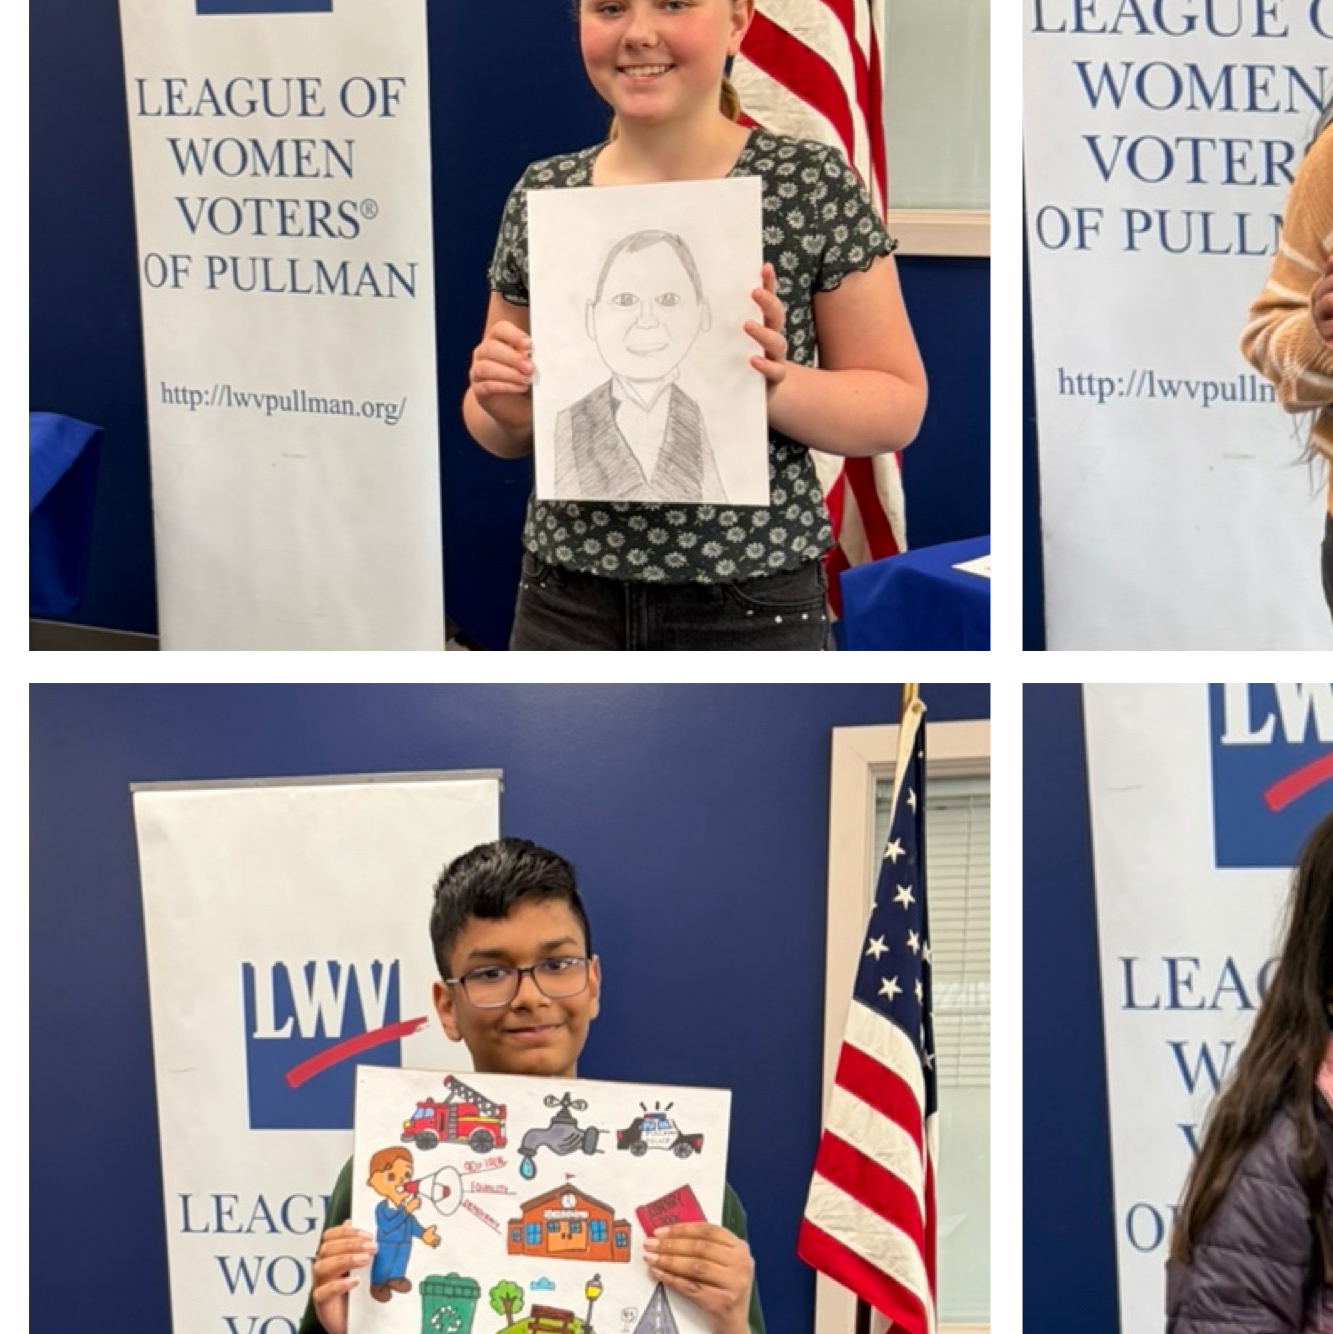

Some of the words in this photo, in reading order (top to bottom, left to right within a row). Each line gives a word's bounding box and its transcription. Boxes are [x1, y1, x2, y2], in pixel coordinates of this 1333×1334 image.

[137, 78, 325, 117] LEAGUE
[340, 77, 405, 117] OF
[1076, 63, 1327, 111] WOMEN
[169, 138, 353, 178] WOMEN
[1084, 136, 1297, 186] VOTER
[1036, 206, 1103, 249] OF
[1123, 210, 1279, 257] PULL
[141, 254, 191, 288] OF
[208, 256, 415, 297] PULLMAN
[161, 382, 406, 425] http://lwvpullman.org/
[244, 959, 400, 1039] LWV
[179, 1192, 320, 1234] LEAG
